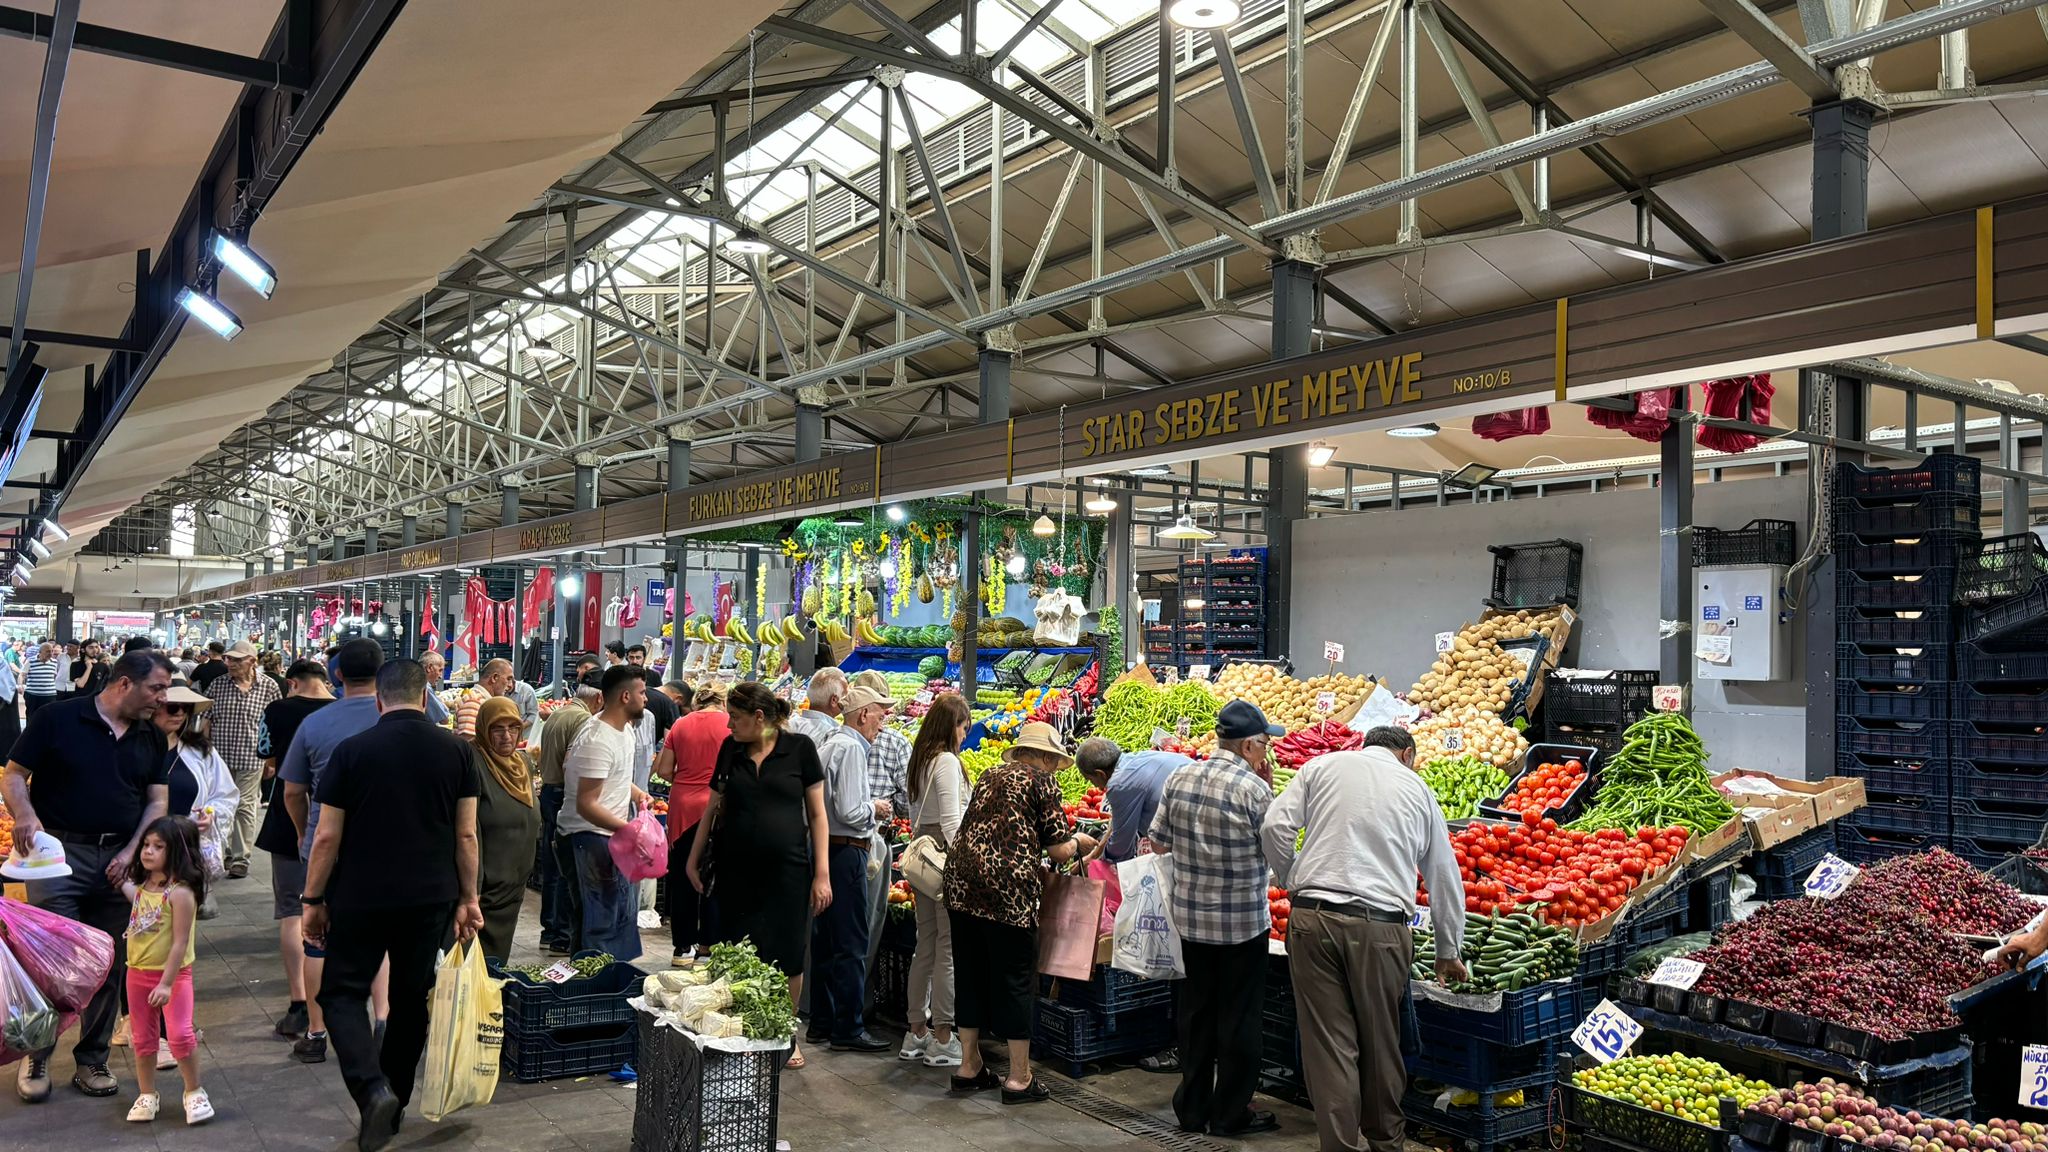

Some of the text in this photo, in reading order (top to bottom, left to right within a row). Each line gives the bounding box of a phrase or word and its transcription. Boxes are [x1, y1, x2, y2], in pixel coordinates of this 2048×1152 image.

[1453, 370, 1511, 394] NO:10/B
[1082, 352, 1423, 456] STAR SEBZE VE MEYVE
[690, 468, 840, 521] FURKAN SEBZE VE MEYVE
[519, 521, 572, 550] KARAÇAY SEBZE
[1327, 651, 1338, 660] 20
[1447, 737, 1458, 749] 35
